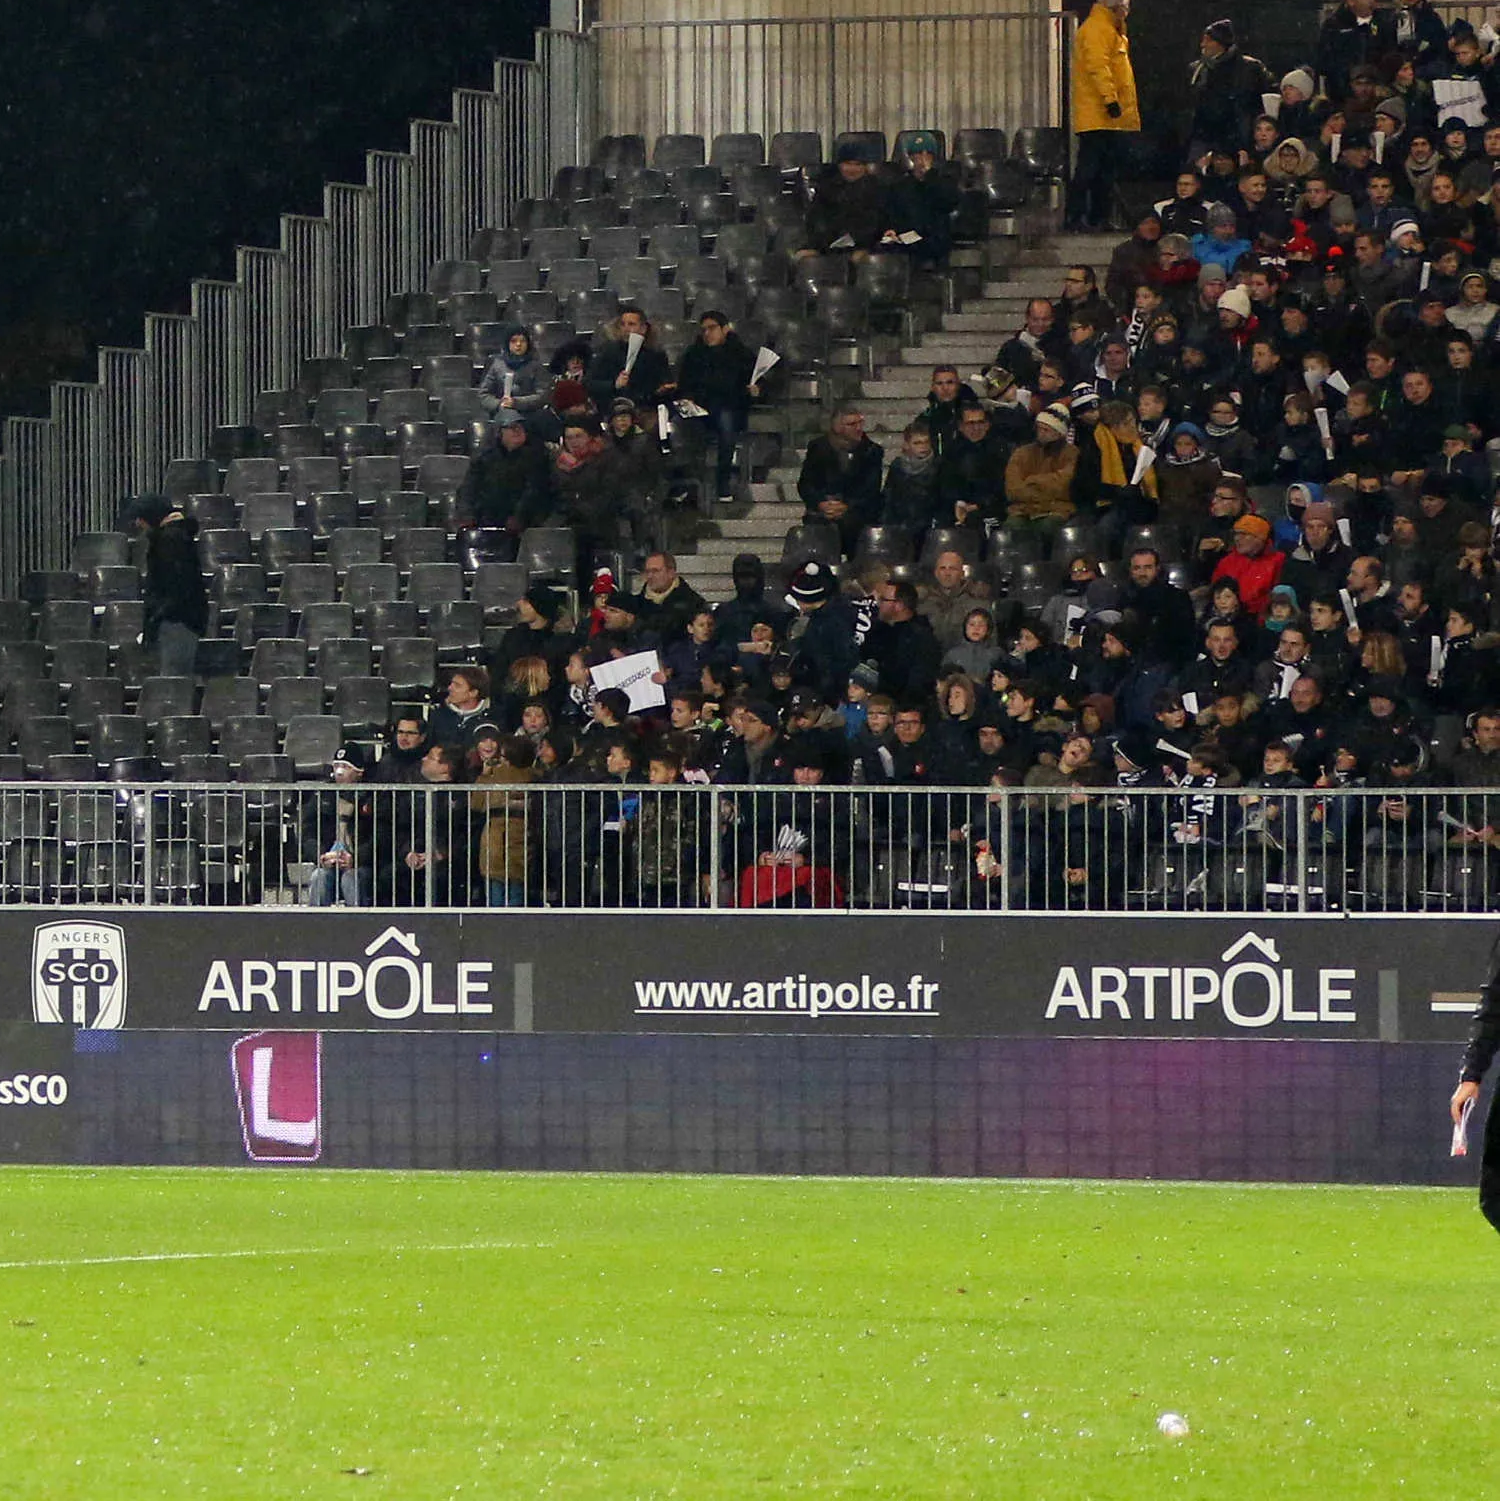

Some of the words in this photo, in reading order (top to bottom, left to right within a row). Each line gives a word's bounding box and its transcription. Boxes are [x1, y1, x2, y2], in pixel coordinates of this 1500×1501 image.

[50, 931, 111, 944] ANGERS
[48, 962, 110, 983] SCO
[634, 975, 940, 1018] www.artipole.fr
